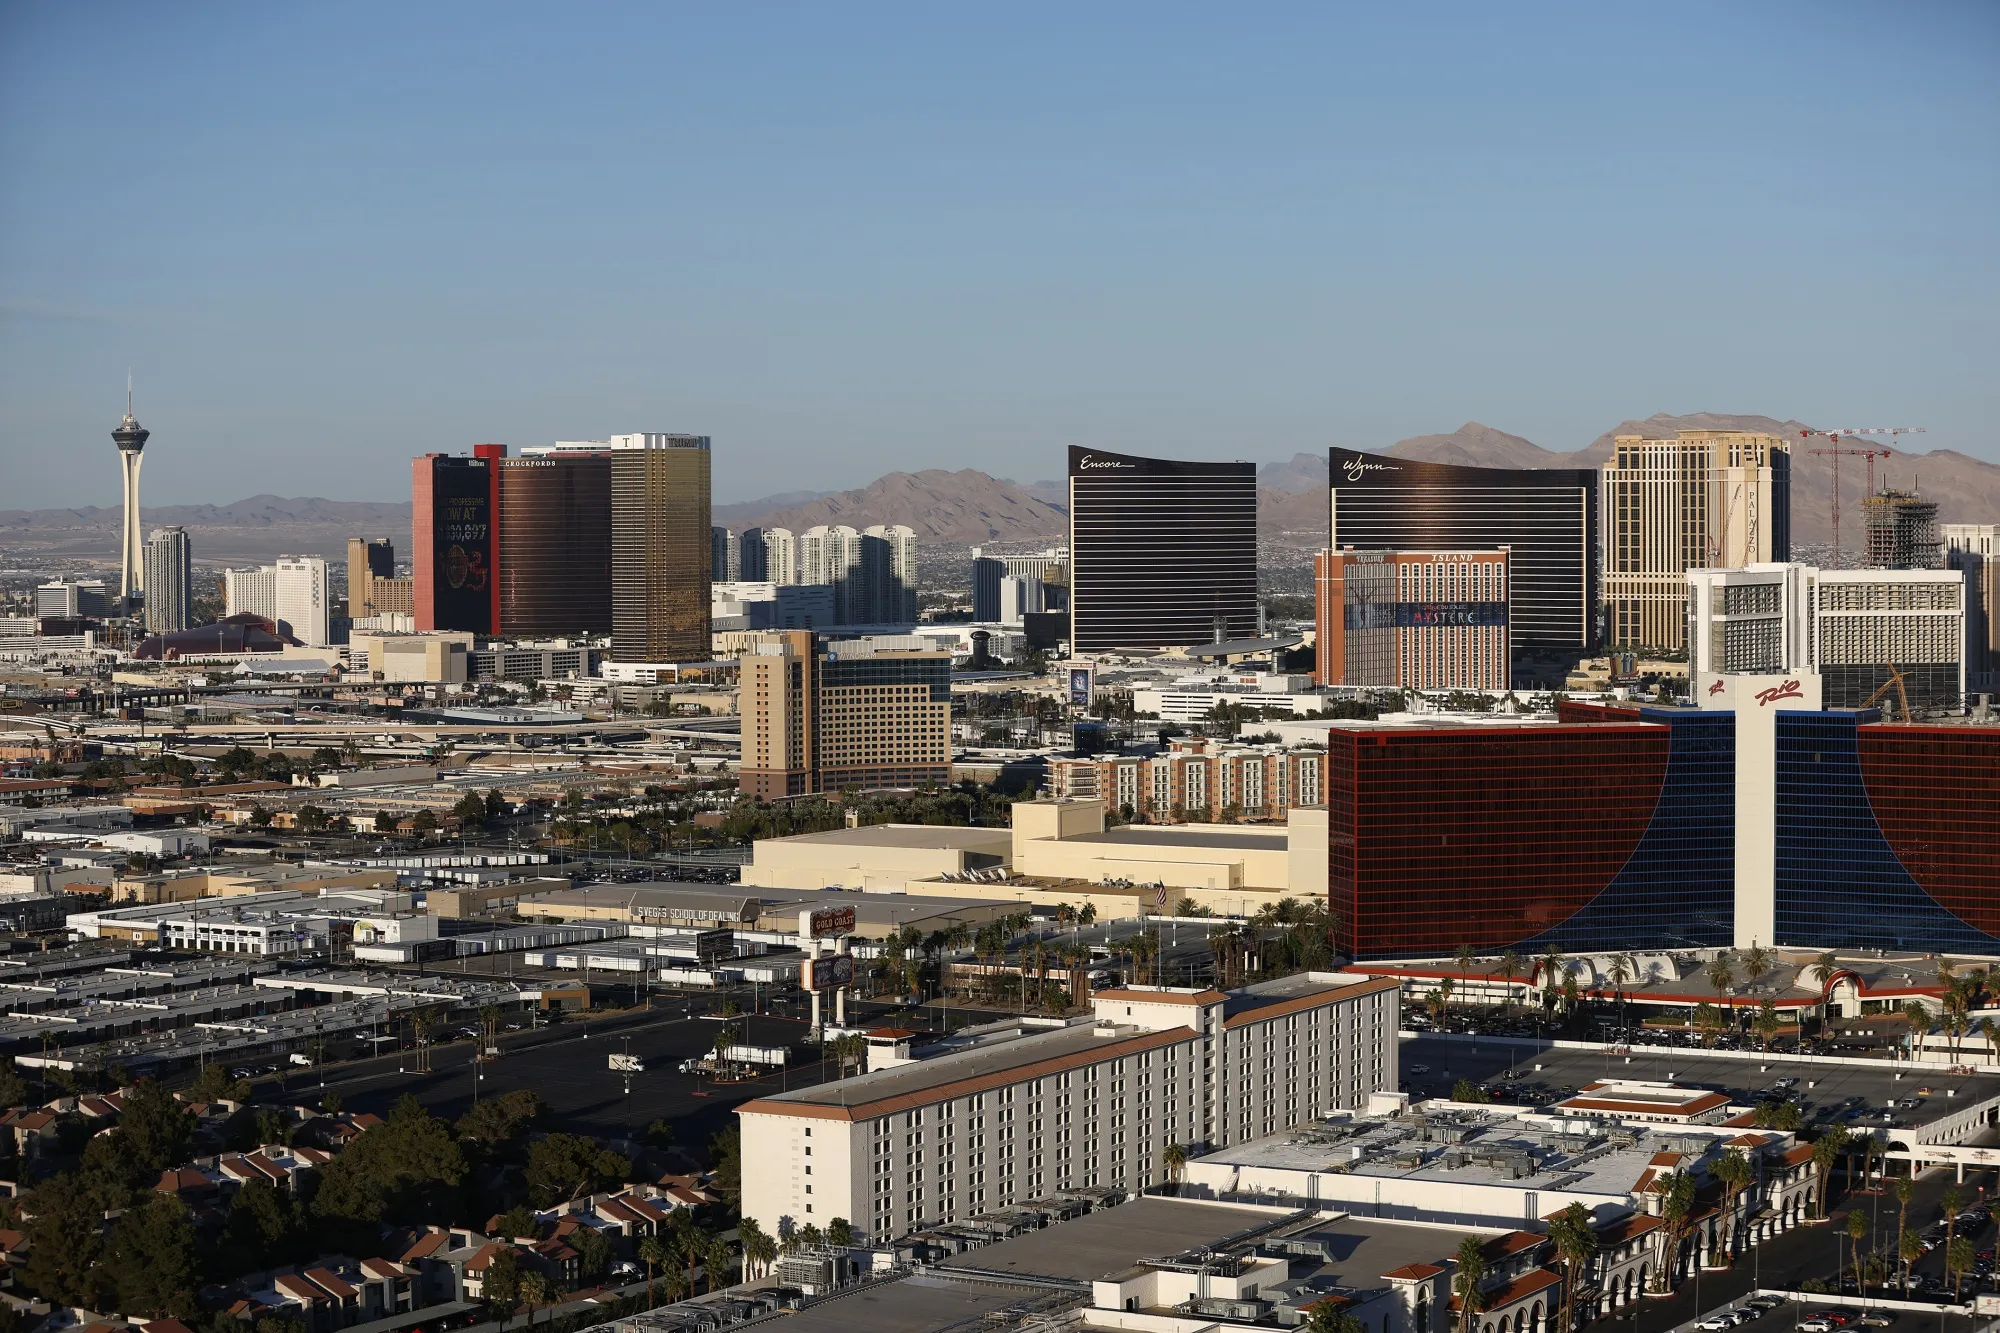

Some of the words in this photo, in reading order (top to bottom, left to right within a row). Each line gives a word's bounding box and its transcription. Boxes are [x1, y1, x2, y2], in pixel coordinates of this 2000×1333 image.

[622, 438, 629, 447] T
[1080, 455, 1135, 470] Encore
[1748, 492, 1757, 553] PALAZZO
[1432, 554, 1473, 562] ISLAND
[1709, 680, 1725, 696] Rio
[1755, 679, 1803, 706] Rio
[670, 908, 698, 919] SCHOOL
[698, 910, 707, 920] OF
[816, 919, 833, 930] GOLD
[834, 915, 854, 927] COAST
